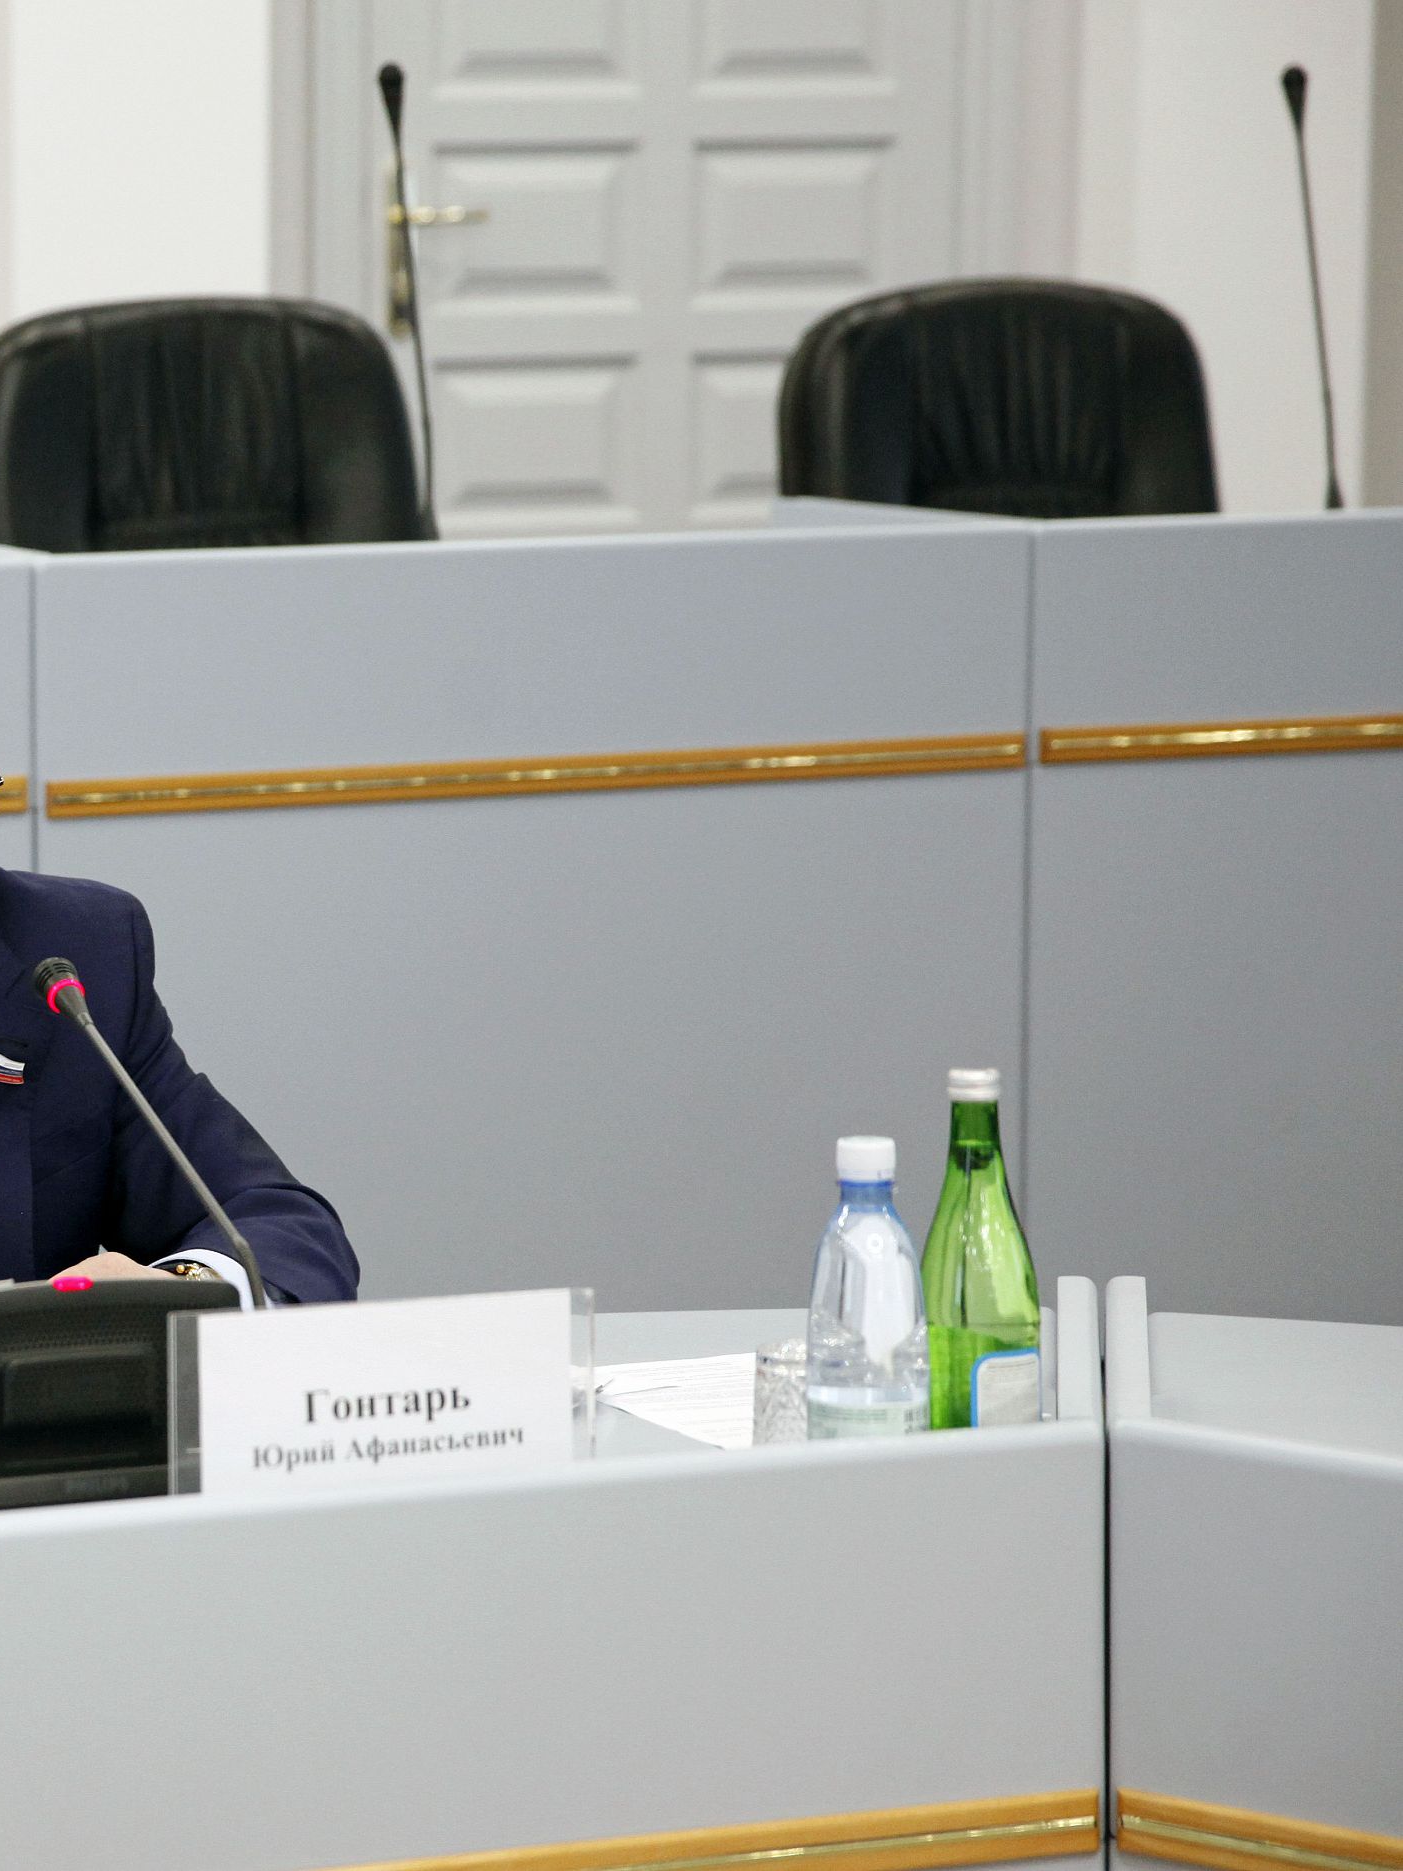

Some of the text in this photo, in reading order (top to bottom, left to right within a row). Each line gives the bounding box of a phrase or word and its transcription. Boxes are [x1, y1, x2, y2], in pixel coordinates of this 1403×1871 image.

[305, 1386, 471, 1422] Гонтарь
[253, 1427, 525, 1471] Юрий Афанасьевич
